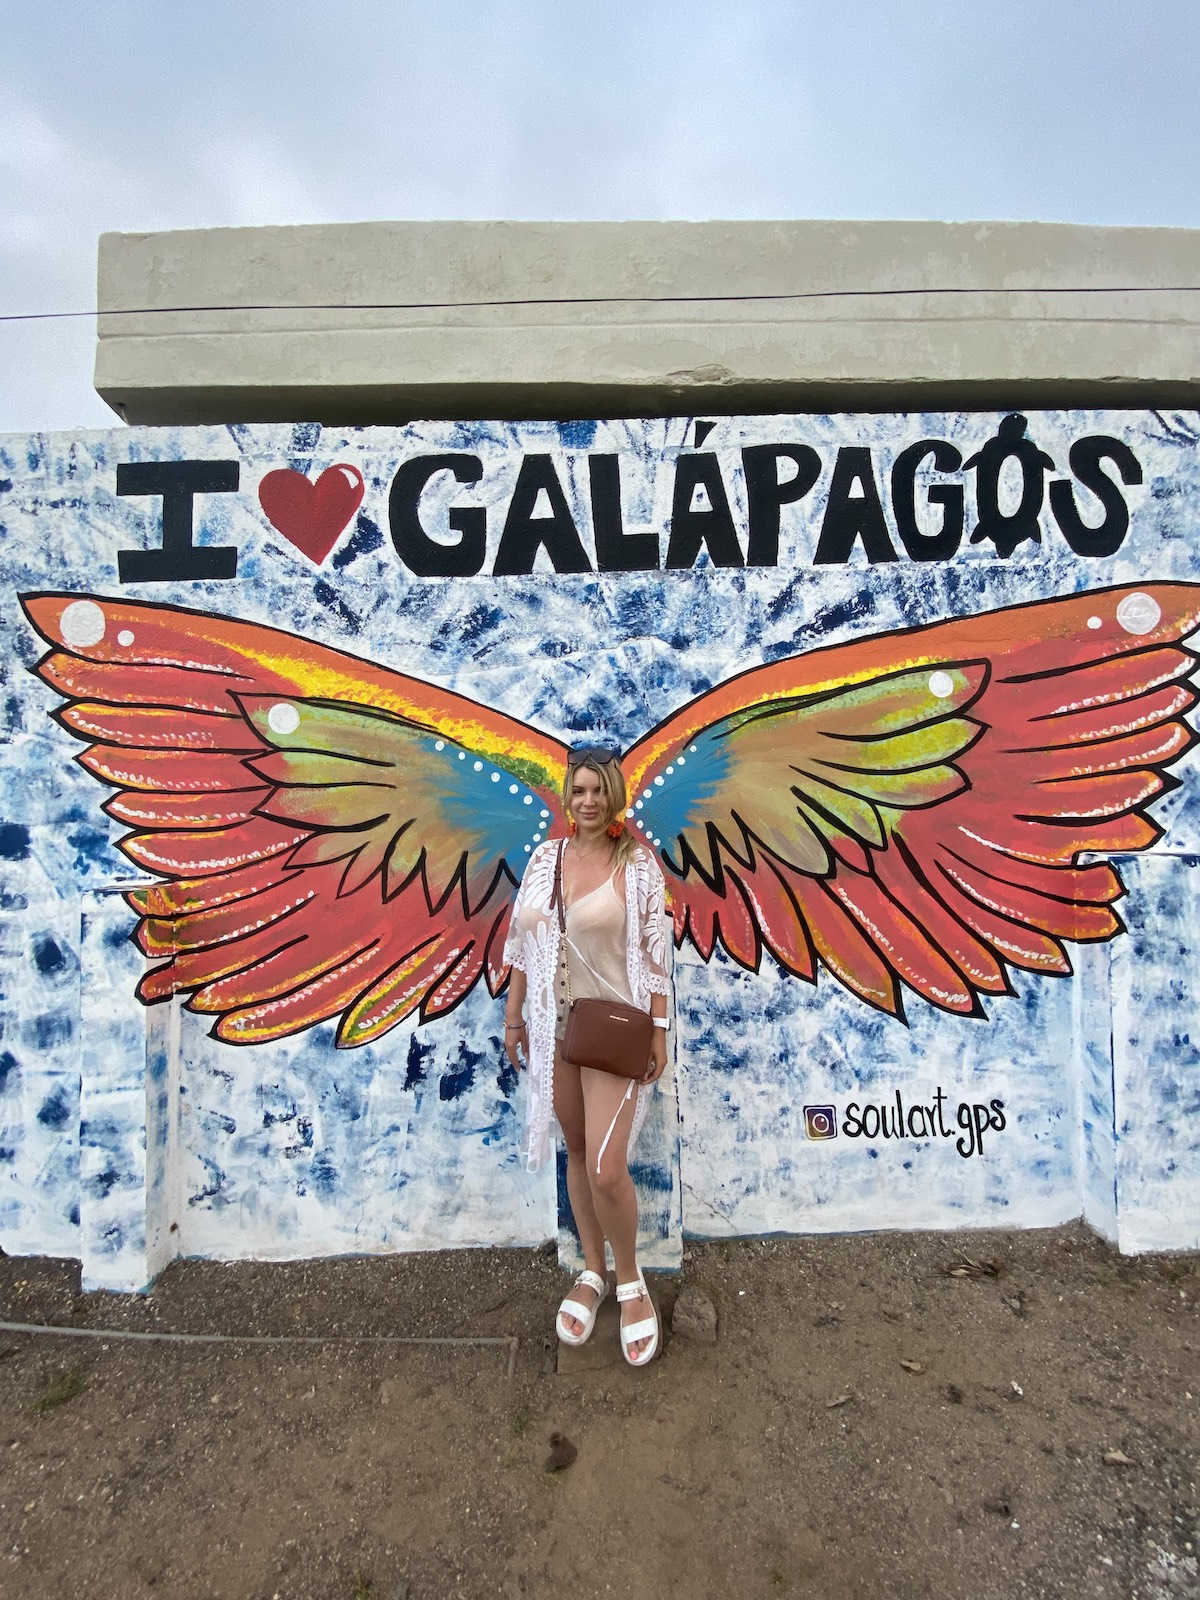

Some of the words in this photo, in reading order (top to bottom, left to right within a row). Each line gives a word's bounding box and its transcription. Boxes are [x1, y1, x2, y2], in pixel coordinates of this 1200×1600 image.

[116, 460, 240, 583] I
[388, 413, 1143, 577] GALÁPAGOS
[842, 1087, 1006, 1158] soul.art.gps
